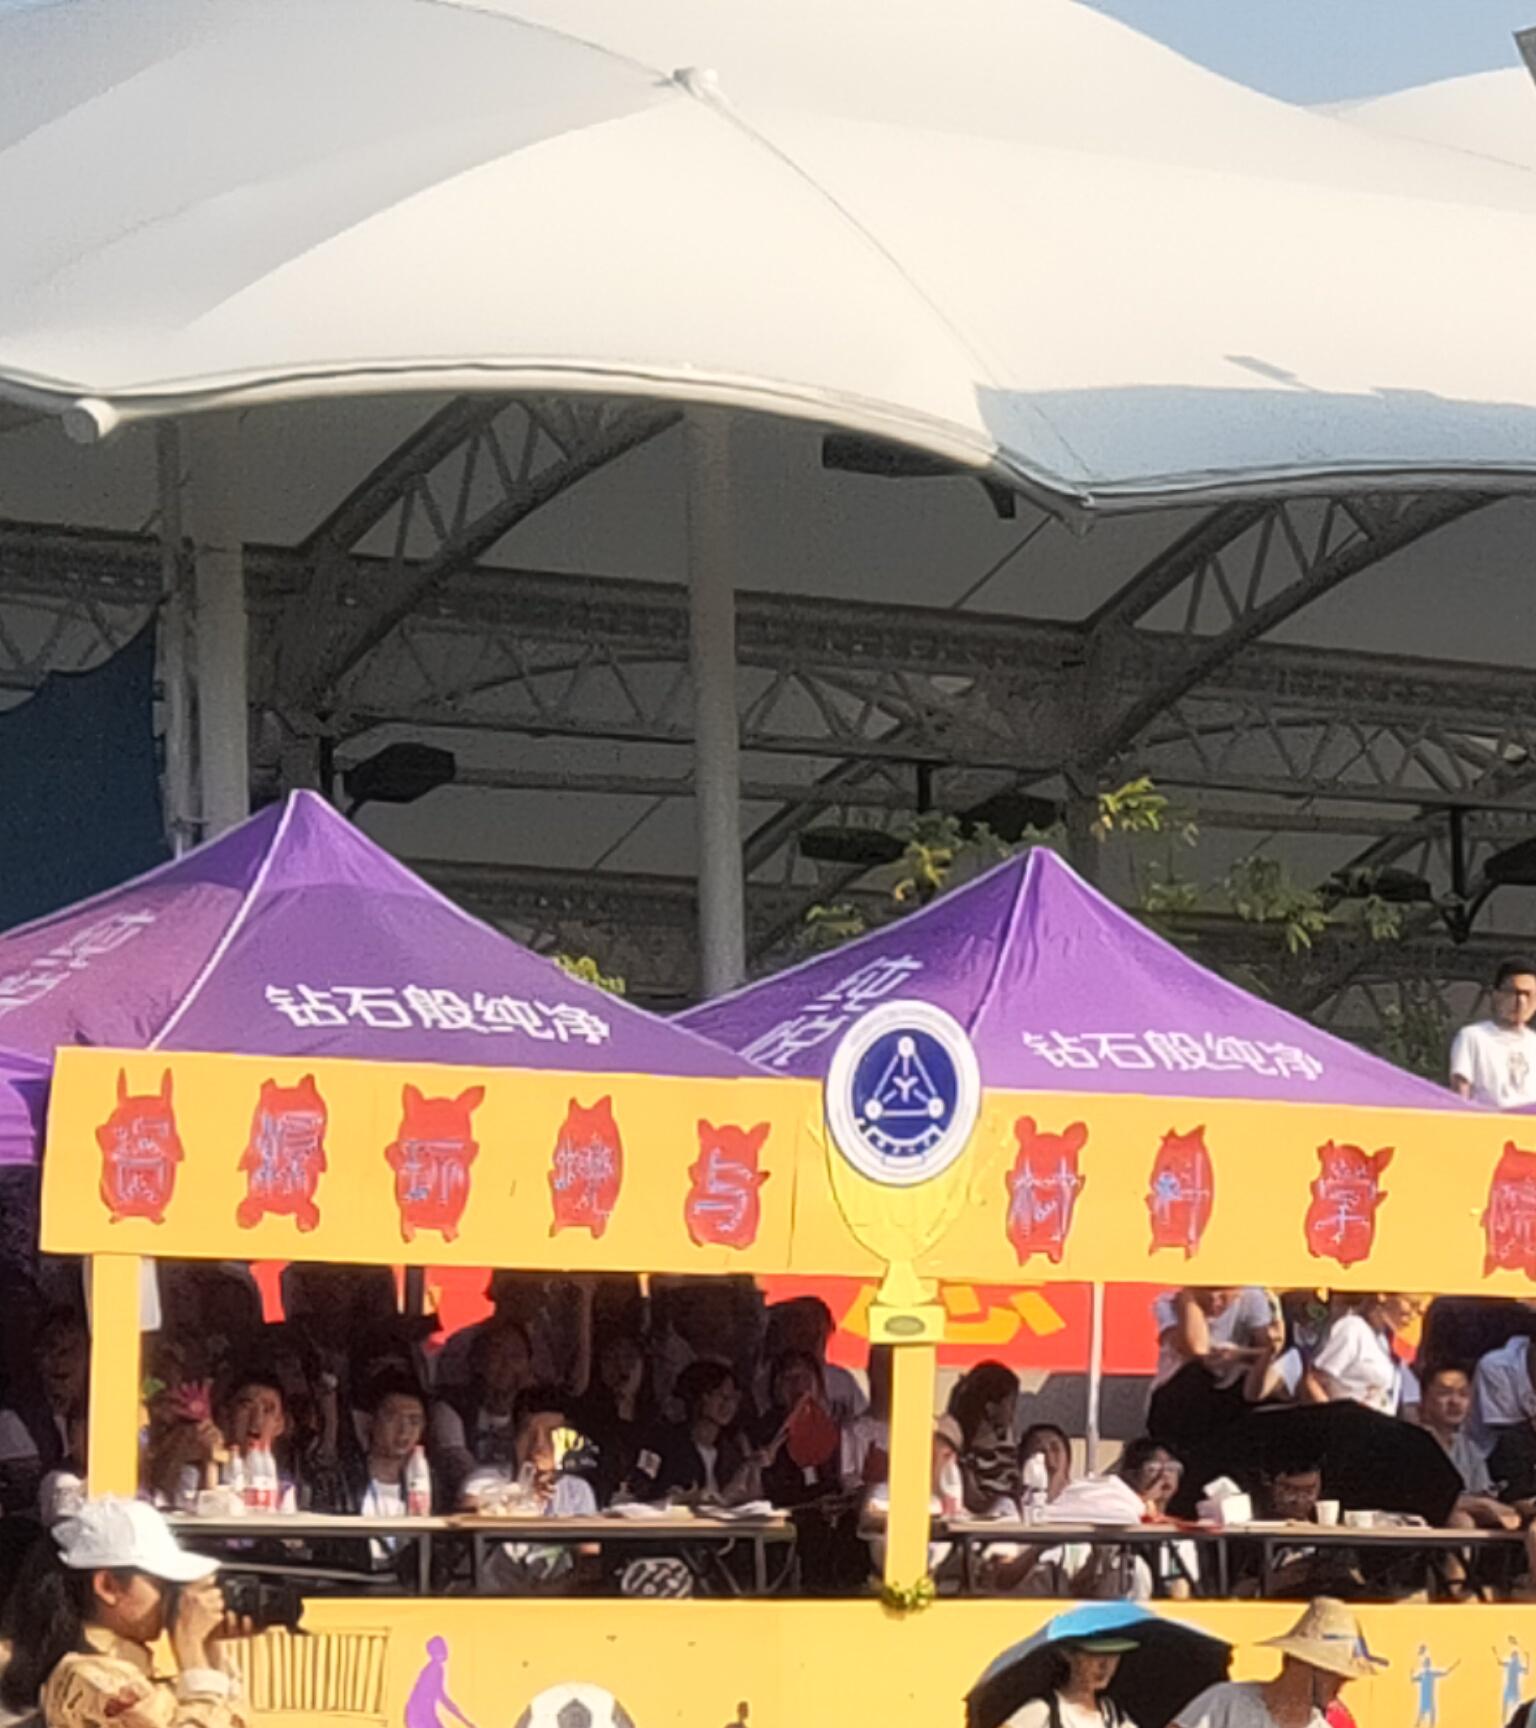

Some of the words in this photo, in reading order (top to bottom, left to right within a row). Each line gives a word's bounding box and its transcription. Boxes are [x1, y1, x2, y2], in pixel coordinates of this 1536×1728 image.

[265, 983, 610, 1046] 钻石般纯净
[1021, 1030, 1324, 1082] 钻石般纯净
